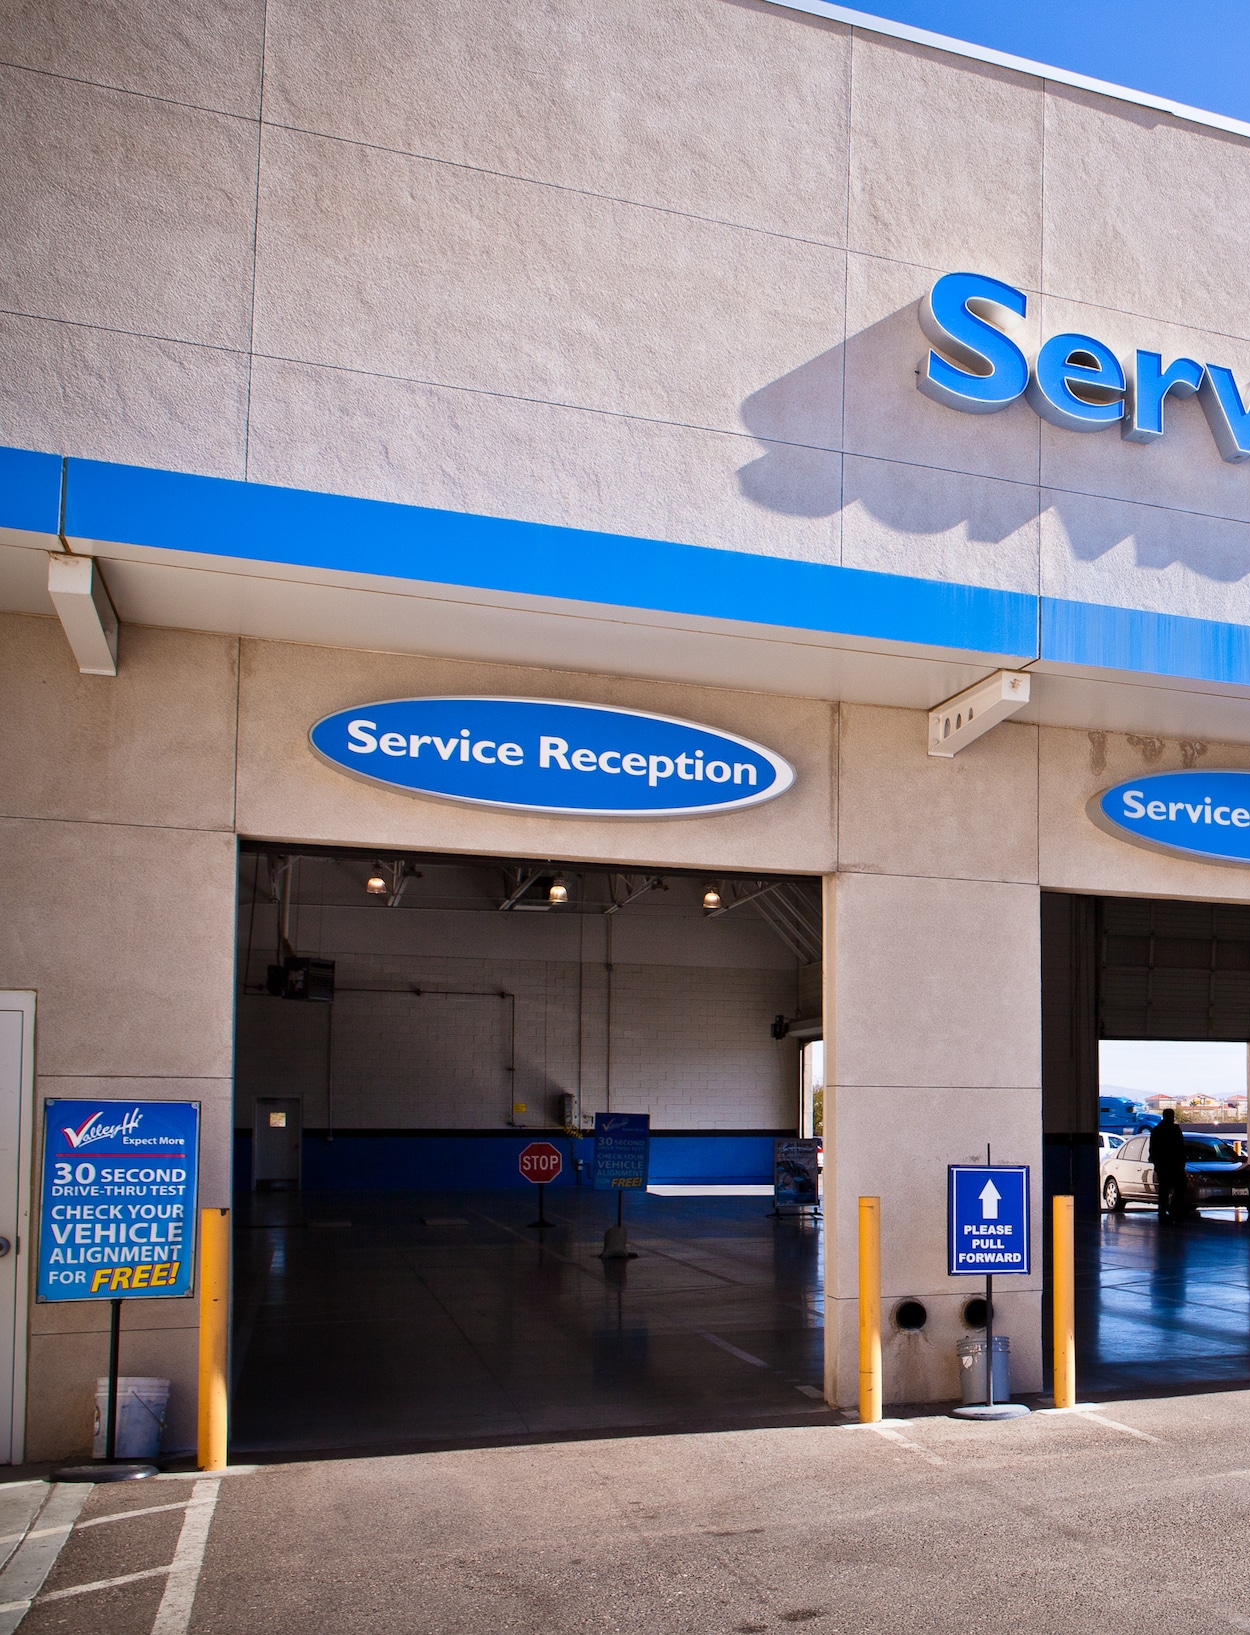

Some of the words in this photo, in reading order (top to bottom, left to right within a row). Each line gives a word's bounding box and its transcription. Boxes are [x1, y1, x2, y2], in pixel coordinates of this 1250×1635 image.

[346, 718, 525, 767] Service
[538, 734, 758, 787] Reception
[1122, 789, 1250, 828] Service
[122, 1136, 157, 1146] Expect
[158, 1136, 185, 1146] More
[597, 1136, 613, 1146] 30
[522, 1154, 560, 1171] STOP
[597, 1152, 623, 1160] CHECK
[624, 1153, 645, 1161] YOUR
[597, 1160, 645, 1170] VEHICLE
[53, 1162, 96, 1184] 30
[101, 1168, 186, 1183] SECOND
[596, 1169, 644, 1178] ALIGNMENT
[610, 1176, 643, 1189] FREE!
[51, 1185, 147, 1197] DRIVE-THRU
[150, 1185, 186, 1196] TEST
[51, 1205, 123, 1220] CHECK
[127, 1204, 184, 1219] YOUR
[51, 1222, 184, 1244] VEHICLE
[963, 1224, 1013, 1236] PLEASE
[972, 1238, 1005, 1249] PULL
[49, 1245, 182, 1264] ALIGNMENT
[958, 1252, 1022, 1263] FORWARD
[49, 1270, 87, 1285] FOR
[90, 1261, 182, 1294] FREE!
